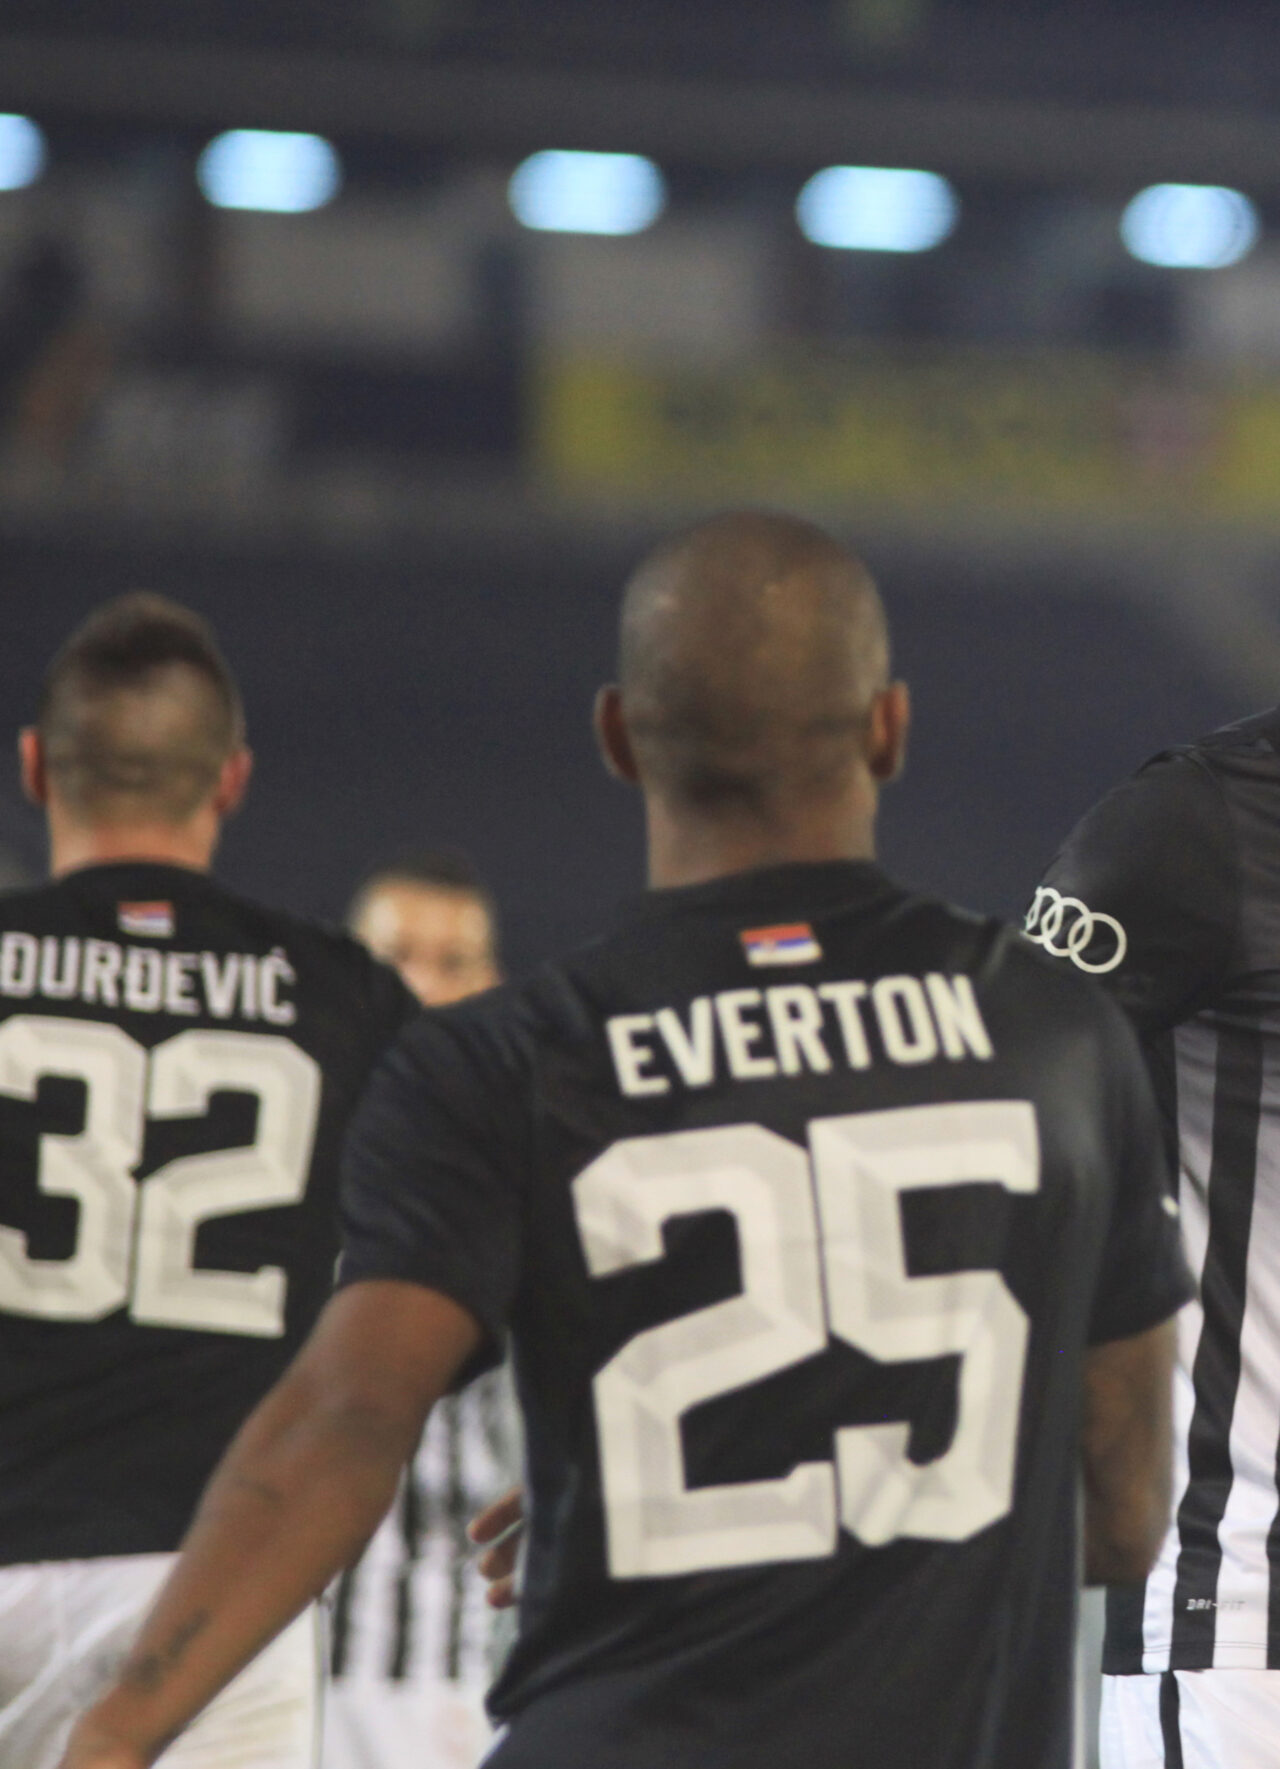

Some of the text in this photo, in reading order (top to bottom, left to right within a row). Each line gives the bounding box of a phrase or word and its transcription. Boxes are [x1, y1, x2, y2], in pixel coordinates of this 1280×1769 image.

[0, 1013, 322, 1338] 32
[606, 972, 994, 1097] EVERTON
[571, 1099, 1041, 1579] 25
